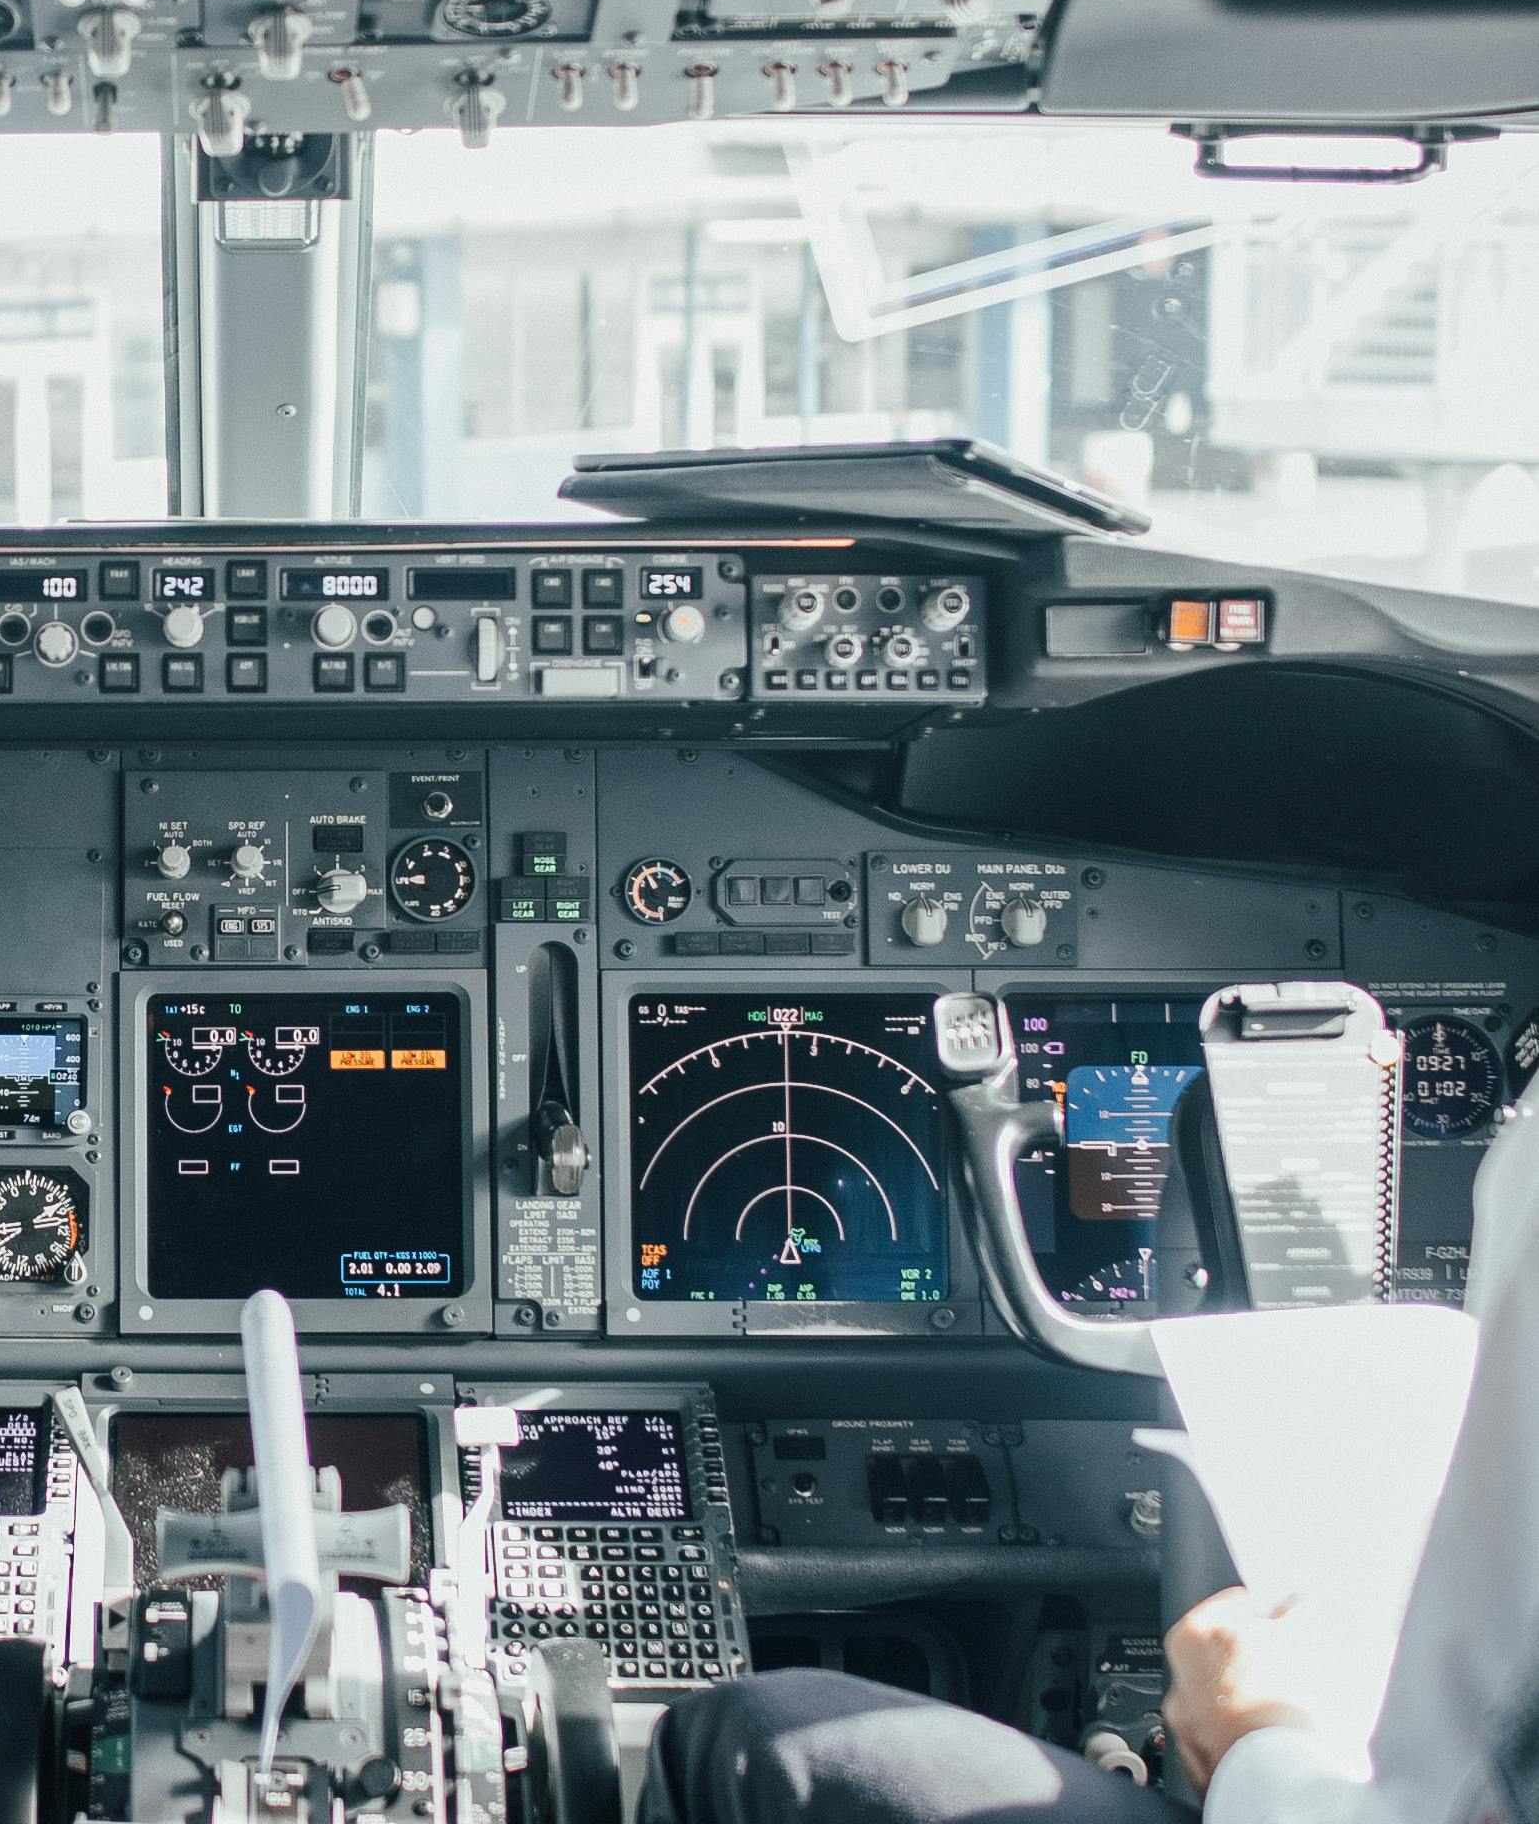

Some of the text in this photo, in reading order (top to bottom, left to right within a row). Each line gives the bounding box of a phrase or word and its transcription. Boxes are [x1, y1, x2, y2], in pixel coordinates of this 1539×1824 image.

[43, 577, 77, 597] 100
[163, 576, 203, 597] 242
[322, 576, 378, 596] 8000
[648, 574, 691, 594] 254
[309, 814, 367, 824] AUTO BRAKE
[228, 821, 266, 831] SPD REF
[163, 830, 185, 839] AUTO
[236, 830, 258, 838] AUTO
[892, 863, 952, 874] LOWER DU
[977, 864, 1004, 874] MAIN
[1005, 864, 1043, 875] PANEL
[146, 892, 200, 902] FUEL FLOW
[512, 901, 534, 910] LEFT
[556, 901, 581, 911] RIGHT
[512, 910, 535, 919] GEAR
[557, 910, 580, 919] GEAR
[312, 916, 353, 926] ANTISKID
[163, 939, 184, 948] USED
[515, 965, 528, 974] UP
[229, 1003, 242, 1014] TO
[772, 1008, 799, 1022] 022
[804, 1010, 824, 1022] MAG
[1023, 1018, 1048, 1032] 100
[210, 1029, 235, 1043] 0.0
[293, 1029, 318, 1043] 0.0
[172, 1037, 183, 1047] 10
[255, 1037, 266, 1047] 10
[511, 1053, 527, 1063] OFF
[1130, 1051, 1148, 1064] FD
[772, 1121, 786, 1133] 10
[230, 1162, 241, 1172] FF
[515, 1200, 582, 1210] LANDING GEAR
[641, 1244, 668, 1256] TCAS
[348, 1262, 442, 1275] 2.01 0.00 2.09
[344, 1283, 401, 1297] TOTAL 4.1
[543, 1415, 602, 1425] APPROACH
[832, 1420, 867, 1428] GROUND
[403, 1727, 428, 1747] 25
[402, 1770, 429, 1791] 30
